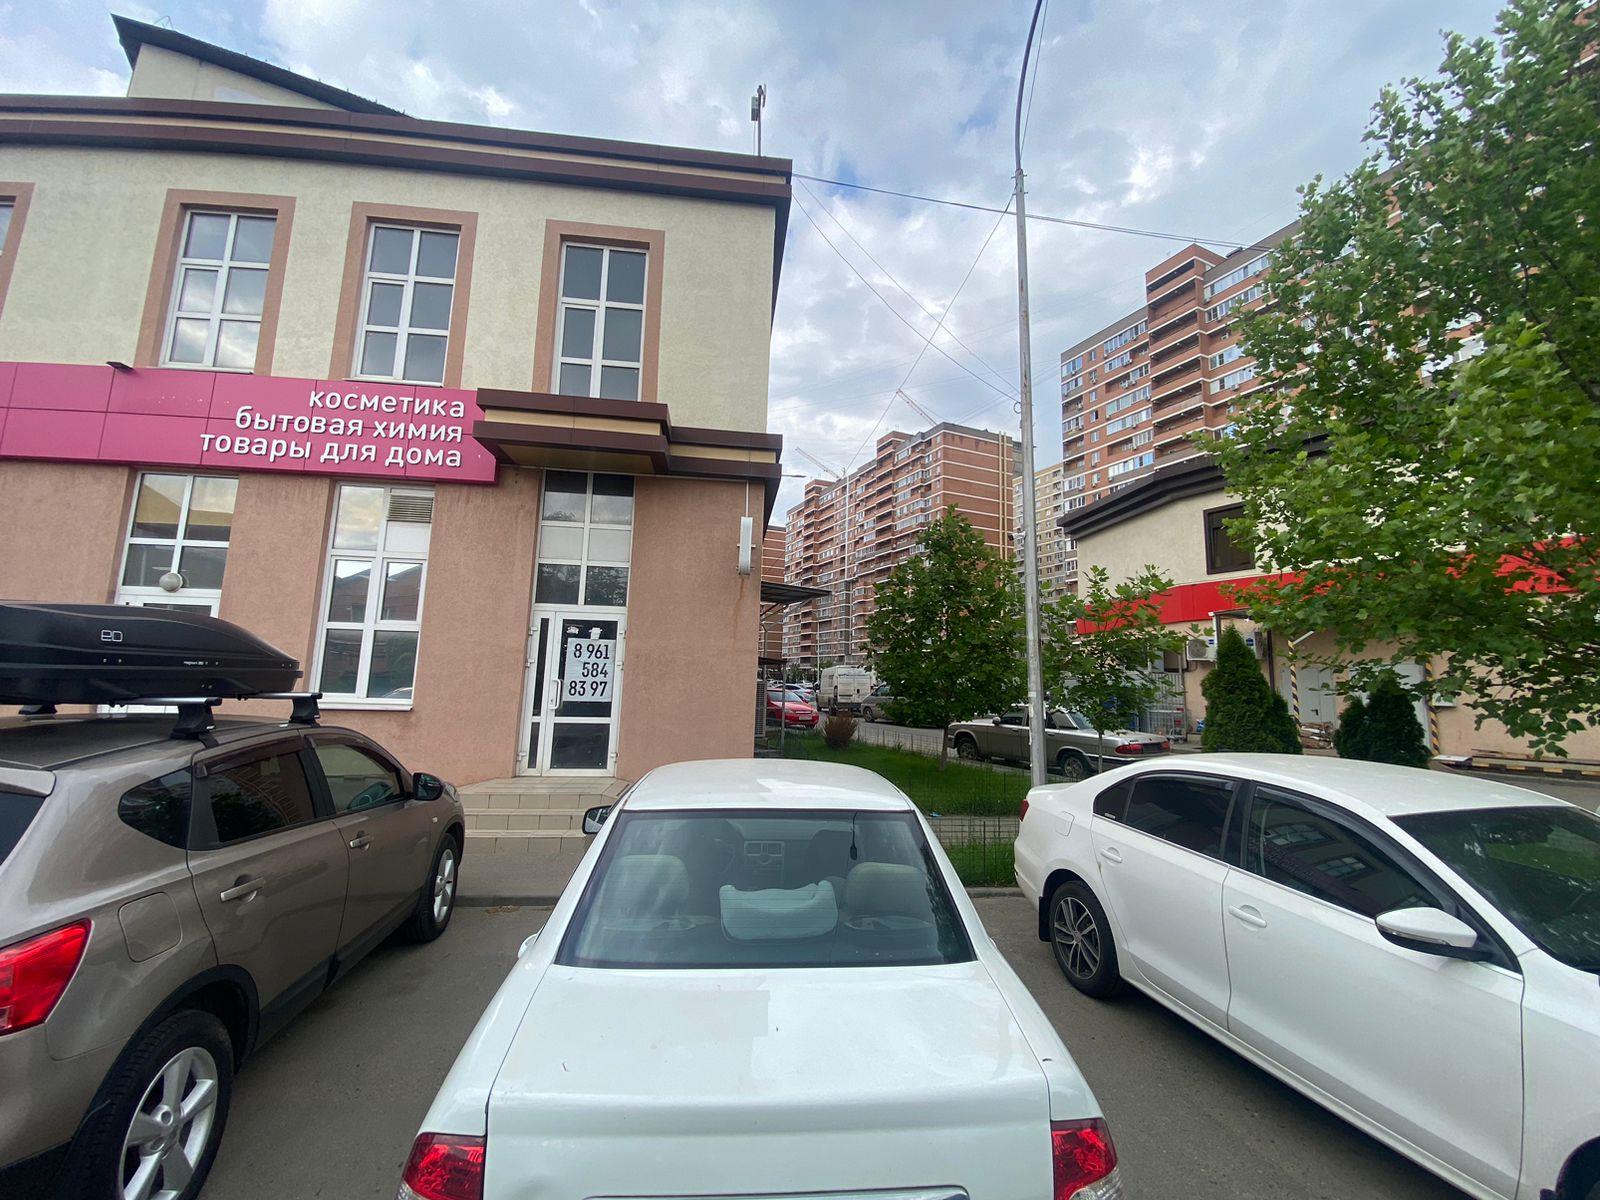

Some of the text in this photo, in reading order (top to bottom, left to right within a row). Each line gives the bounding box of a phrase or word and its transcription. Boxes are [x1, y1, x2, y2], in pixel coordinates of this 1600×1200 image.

[308, 390, 465, 419] косметика
[235, 405, 463, 443] бытовая химия
[200, 433, 462, 469] товары для дома
[574, 643, 609, 659] 8 961
[582, 662, 609, 678] 584
[568, 680, 608, 697] 83 97
